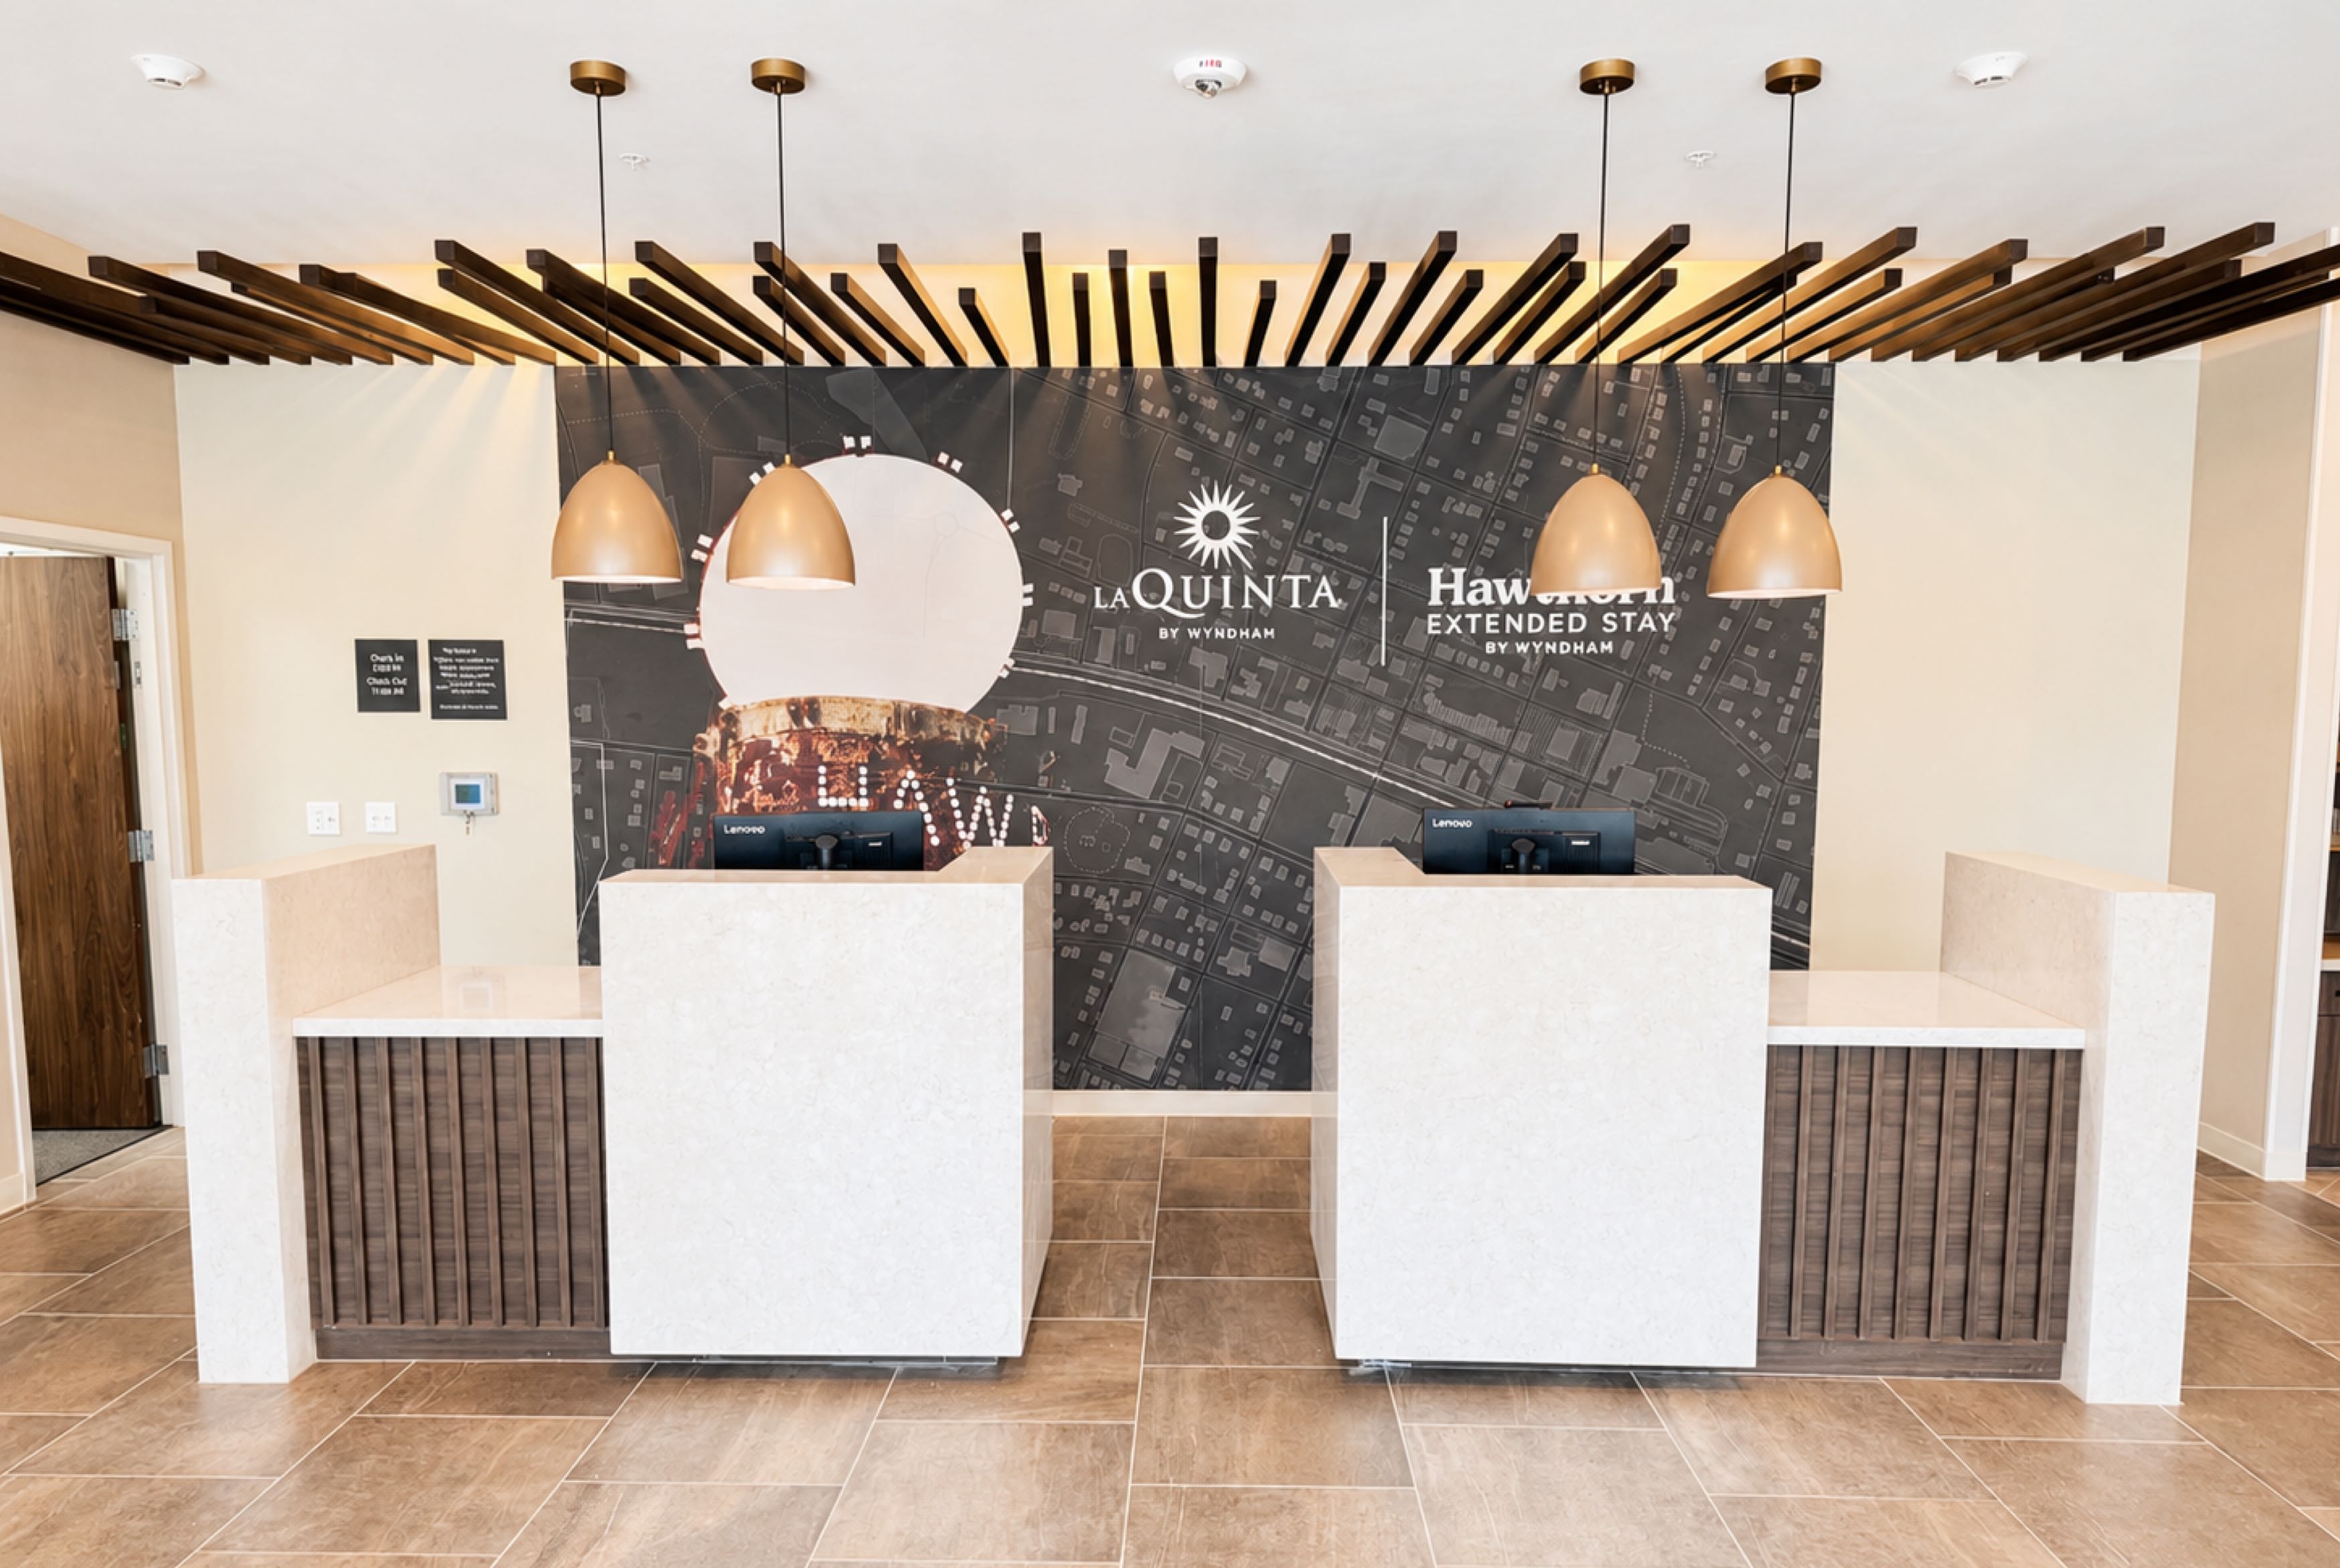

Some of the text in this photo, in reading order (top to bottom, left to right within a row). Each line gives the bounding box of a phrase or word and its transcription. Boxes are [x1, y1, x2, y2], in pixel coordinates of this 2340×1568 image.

[1094, 567, 1342, 619] LA QUINTA
[1427, 611, 1676, 635] EXTENDED STAY
[1159, 627, 1275, 639] BY WYNDHAM
[1486, 640, 1613, 654] BY WYNDHAM
[723, 823, 766, 835] Lenovo
[1432, 818, 1473, 829] Lenovo
